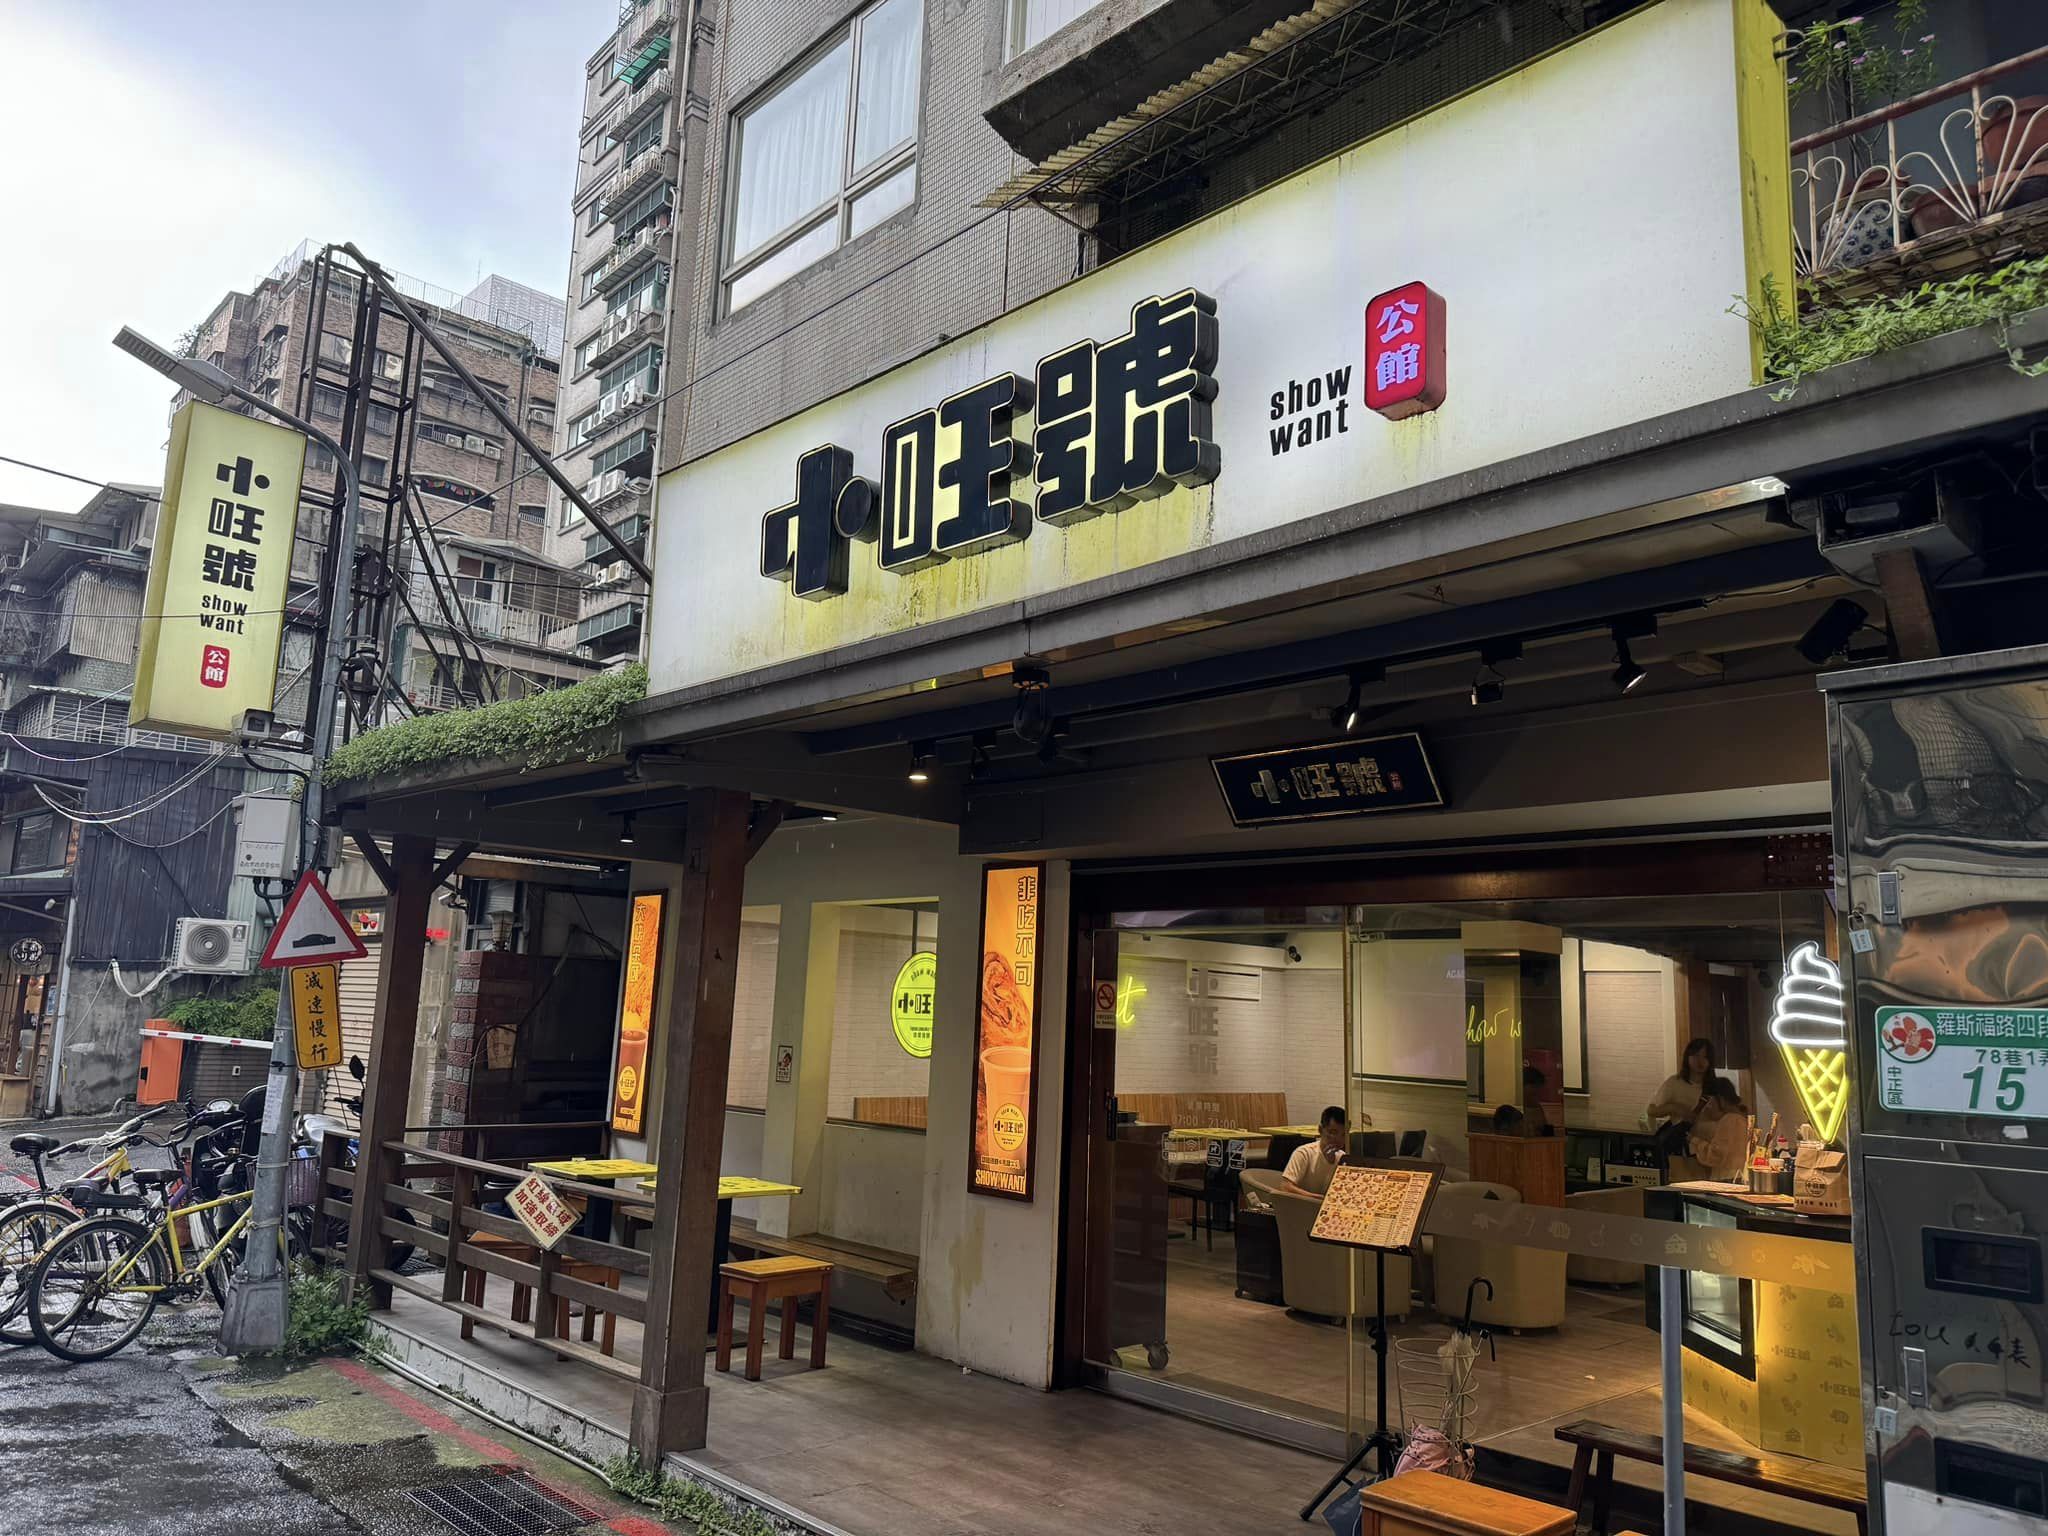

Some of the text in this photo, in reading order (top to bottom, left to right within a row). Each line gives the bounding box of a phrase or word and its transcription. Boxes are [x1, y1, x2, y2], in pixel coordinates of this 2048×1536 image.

[1375, 299, 1421, 391] 公館
[1270, 365, 1352, 420] show
[761, 288, 1219, 600] 小旺號
[1270, 399, 1349, 456] want
[202, 455, 271, 593] 小旺號
[200, 613, 245, 635] want
[201, 594, 248, 616] show
[205, 650, 227, 682] 公館
[1015, 875, 1037, 987] 非吃不可
[304, 971, 328, 1064] 減速慢行
[1887, 1065, 1903, 1105] 中正區
[1963, 1065, 2027, 1112] 15
